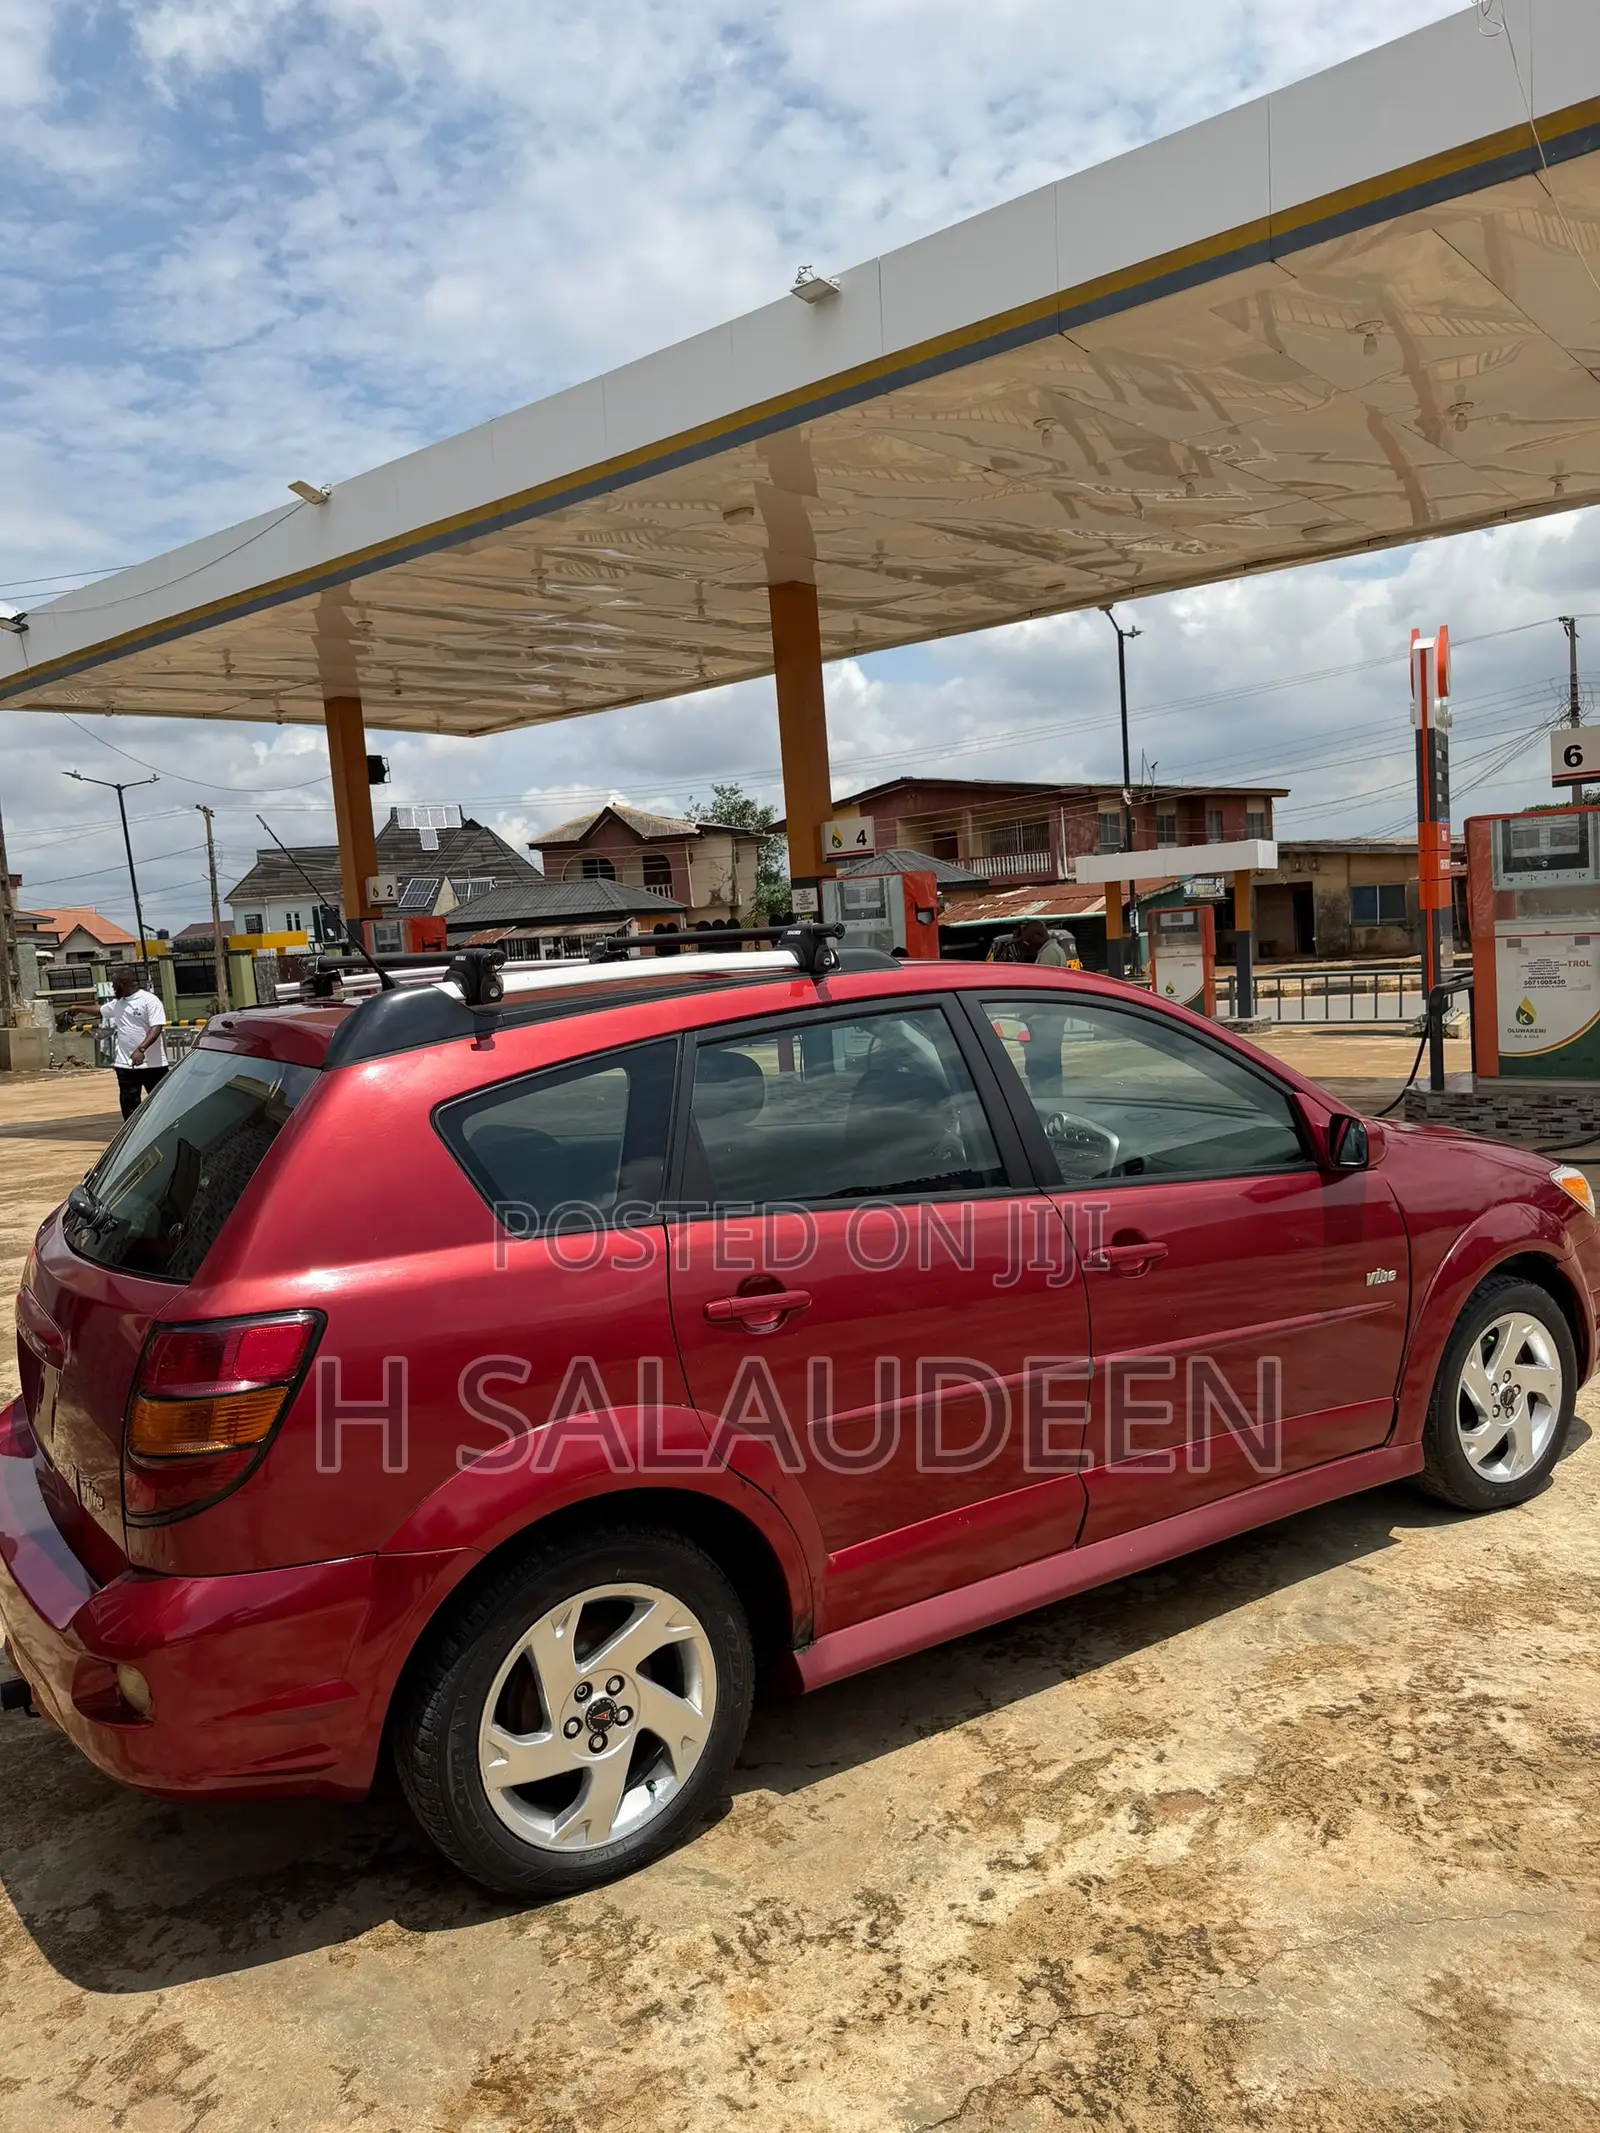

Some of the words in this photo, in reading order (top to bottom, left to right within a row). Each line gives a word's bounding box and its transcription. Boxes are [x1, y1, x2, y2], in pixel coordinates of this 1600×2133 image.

[1564, 744, 1583, 768] 6
[856, 829, 867, 846] 4
[386, 884, 394, 897] 2
[1567, 959, 1592, 968] TROL
